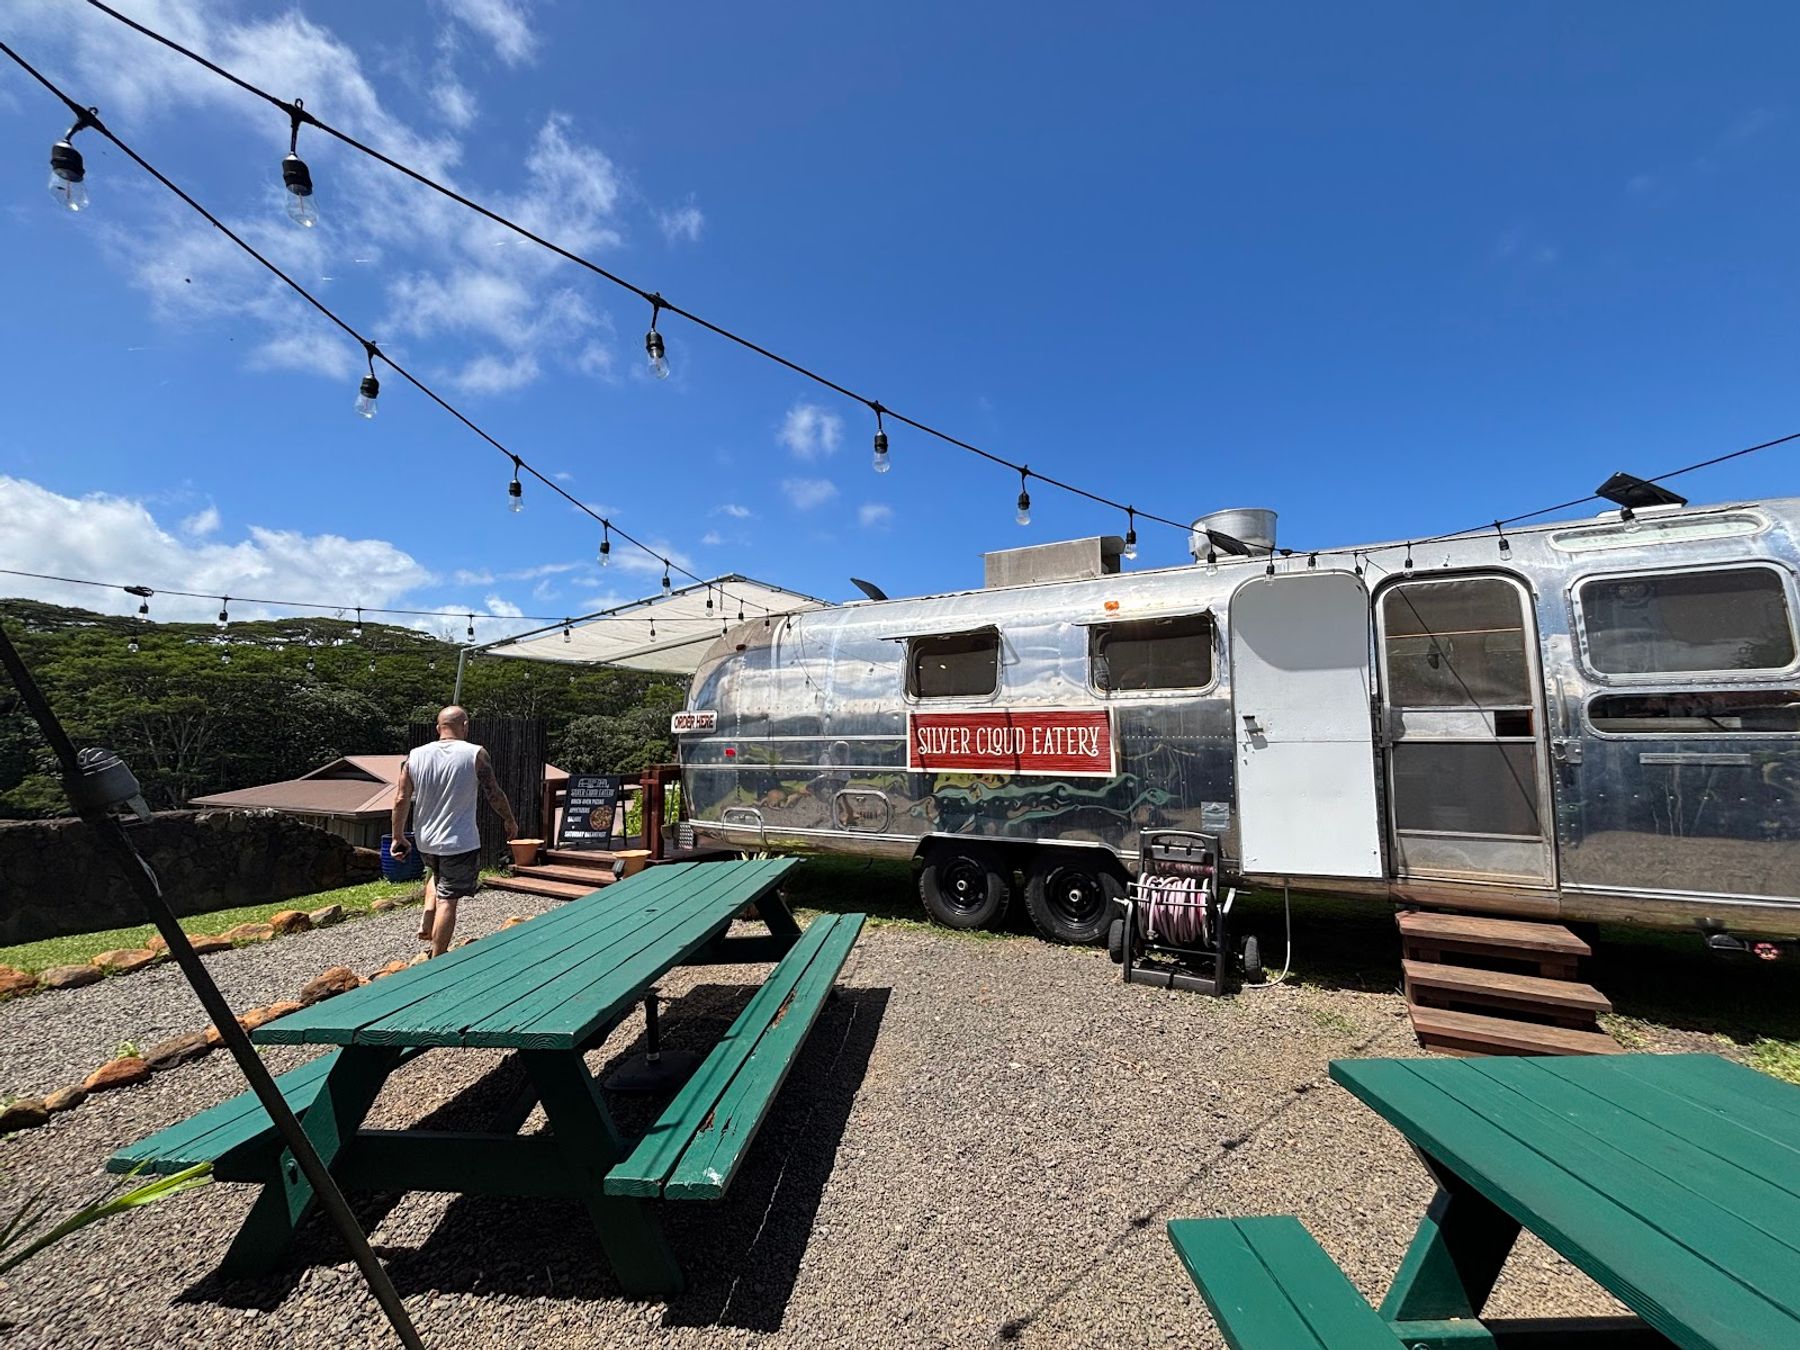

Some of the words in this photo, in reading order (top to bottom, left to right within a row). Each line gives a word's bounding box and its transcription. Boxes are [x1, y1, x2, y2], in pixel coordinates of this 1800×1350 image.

[674, 715, 695, 729] ORDER
[696, 714, 714, 729] HERE
[917, 727, 971, 755] SILVER
[976, 726, 1026, 756] CLOUD
[1032, 726, 1101, 757] EATERY
